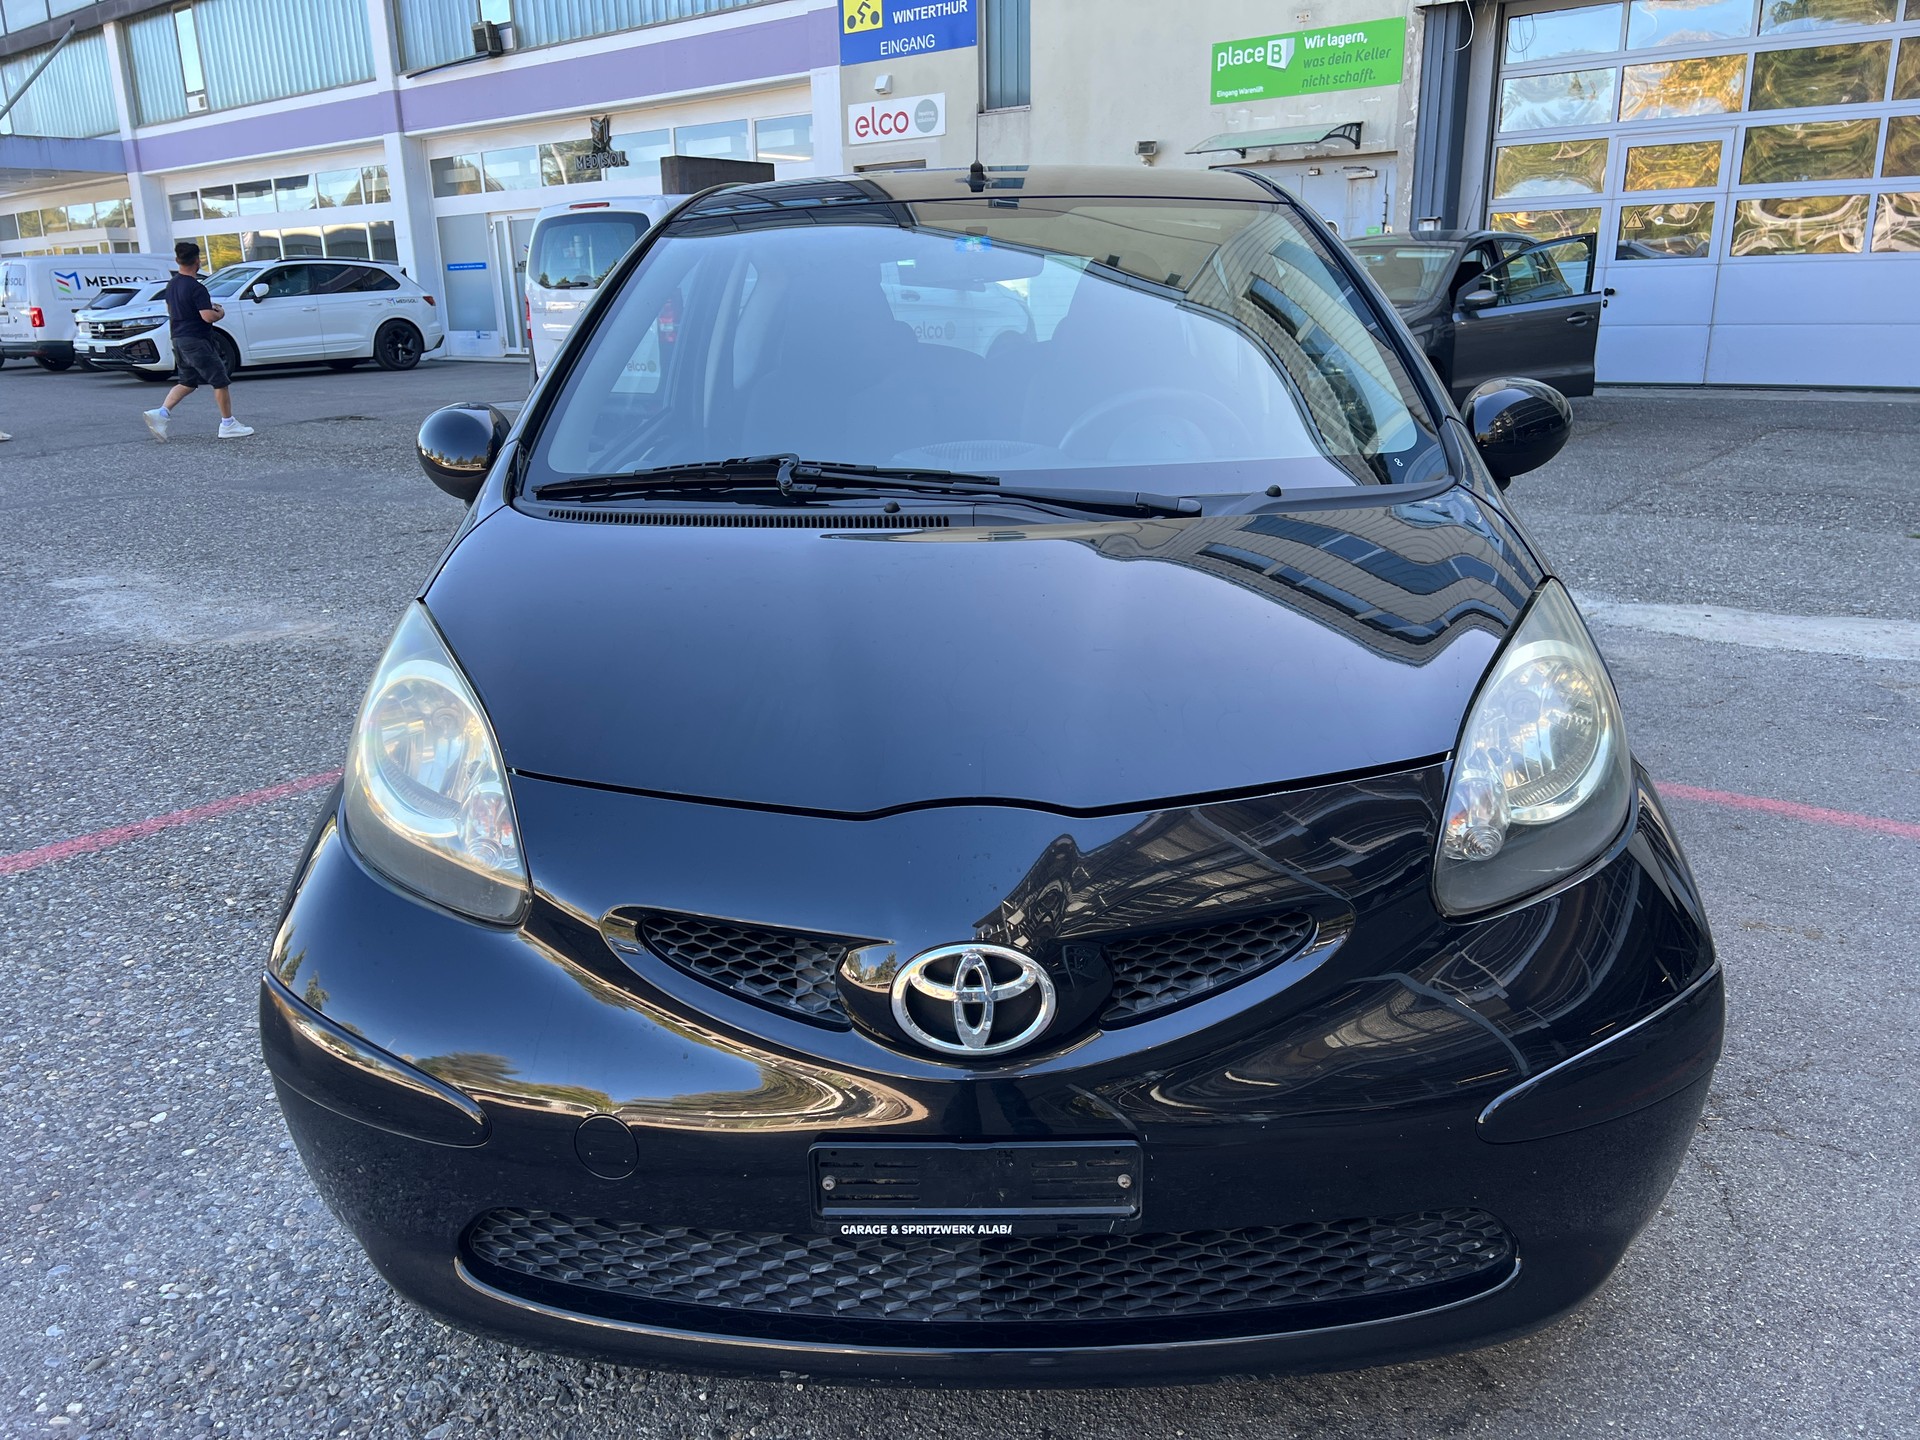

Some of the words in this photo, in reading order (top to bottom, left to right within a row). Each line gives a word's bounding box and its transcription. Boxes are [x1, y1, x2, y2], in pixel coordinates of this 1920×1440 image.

[892, 0, 969, 24] WINTERTHUR
[880, 33, 936, 56] EINGANG
[1303, 35, 1325, 50] Wir
[1327, 31, 1368, 49] lagern,
[1303, 56, 1325, 69] was
[1327, 50, 1352, 66] dein
[1354, 47, 1392, 62] Keller
[1301, 73, 1331, 89] nicht
[1216, 87, 1238, 98] Eingang
[855, 106, 909, 138] elco
[575, 150, 630, 171] MEDISOL
[914, 321, 943, 340] elco
[627, 360, 646, 372] elco
[841, 1225, 888, 1235] GARAGE
[890, 1225, 899, 1235] &
[901, 1225, 975, 1235] SPRITZWERK
